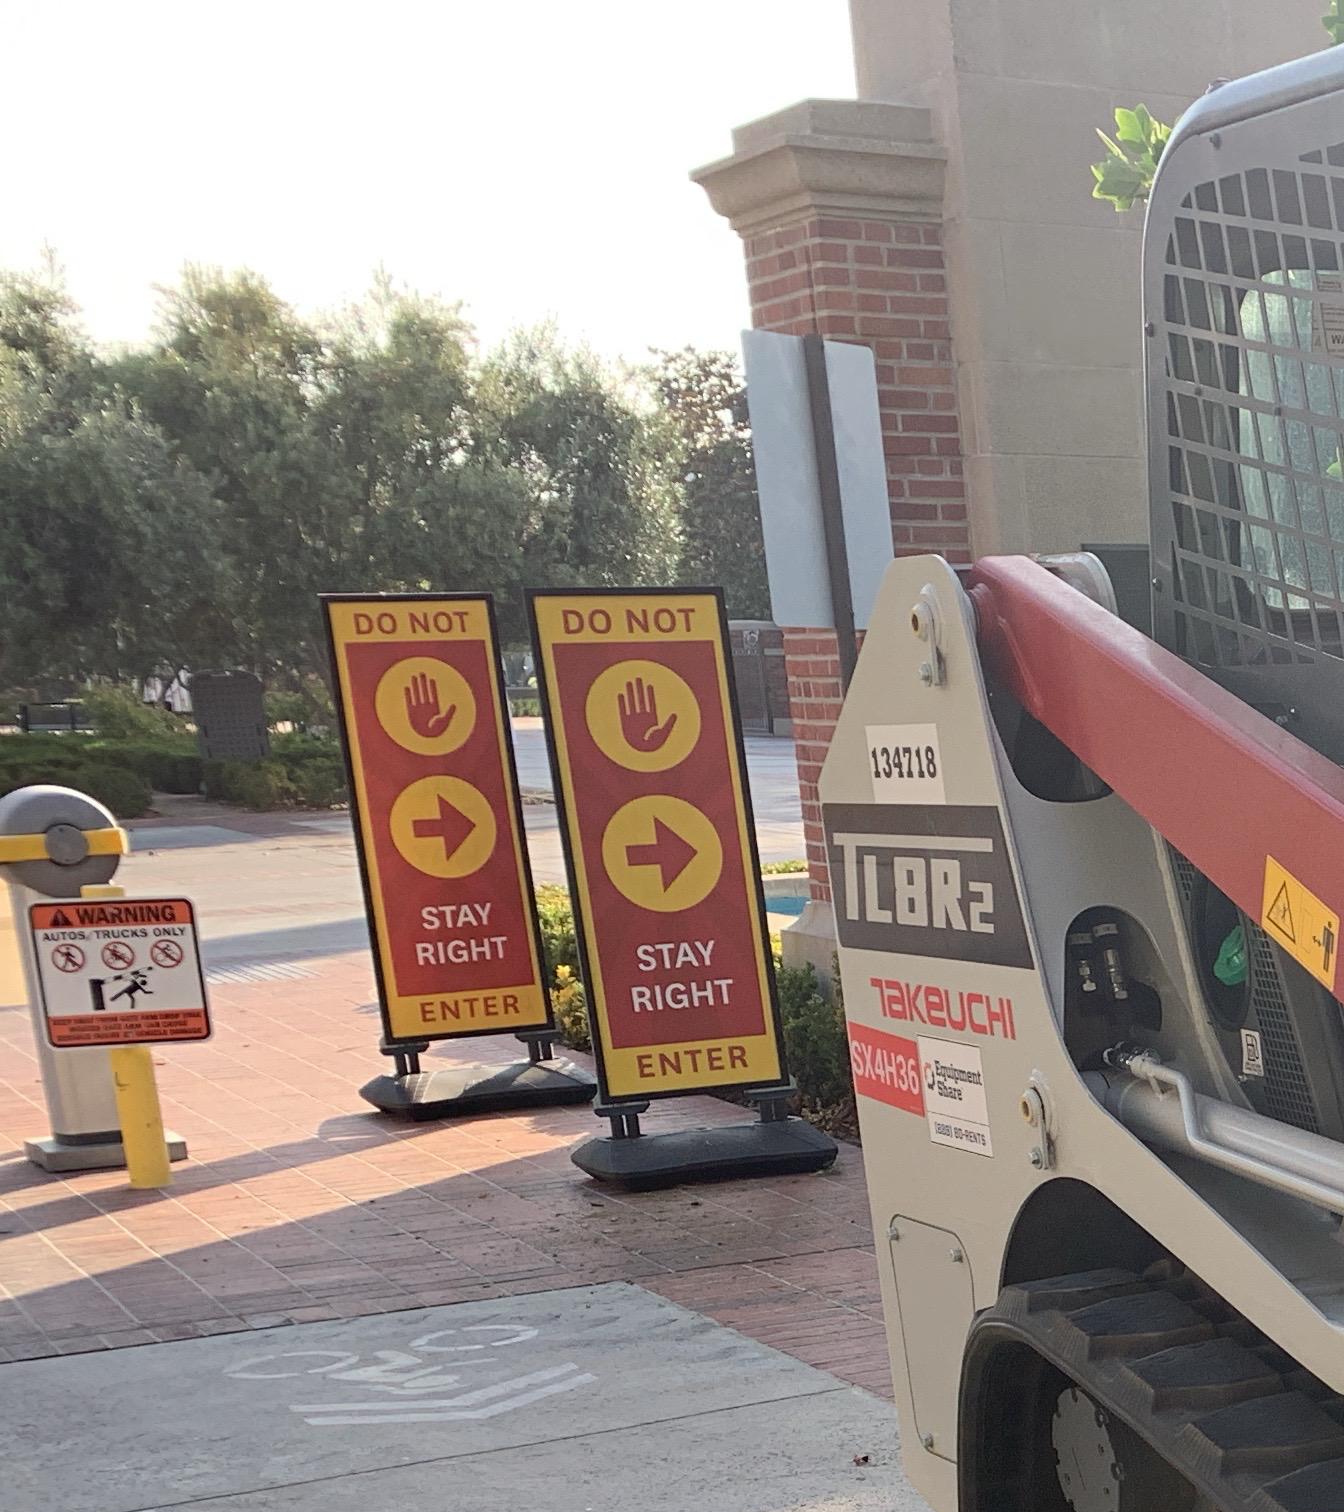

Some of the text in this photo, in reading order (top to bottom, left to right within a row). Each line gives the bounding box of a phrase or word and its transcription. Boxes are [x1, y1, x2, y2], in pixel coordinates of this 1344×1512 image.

[353, 611, 469, 635] DO NOT
[562, 608, 696, 635] DO NOT
[871, 746, 938, 779] 134718
[76, 904, 176, 926] WARNING
[421, 902, 492, 930] STAY
[153, 927, 186, 938] ONLY
[415, 936, 507, 966] RIGHT
[636, 940, 715, 972] STAY
[420, 994, 520, 1023] ENTER
[631, 978, 734, 1013] RIGHT
[636, 1045, 748, 1078] ENTER
[851, 1040, 919, 1096] SX4H36
[934, 1060, 983, 1086] Equipment
[937, 1080, 963, 1101] Share
